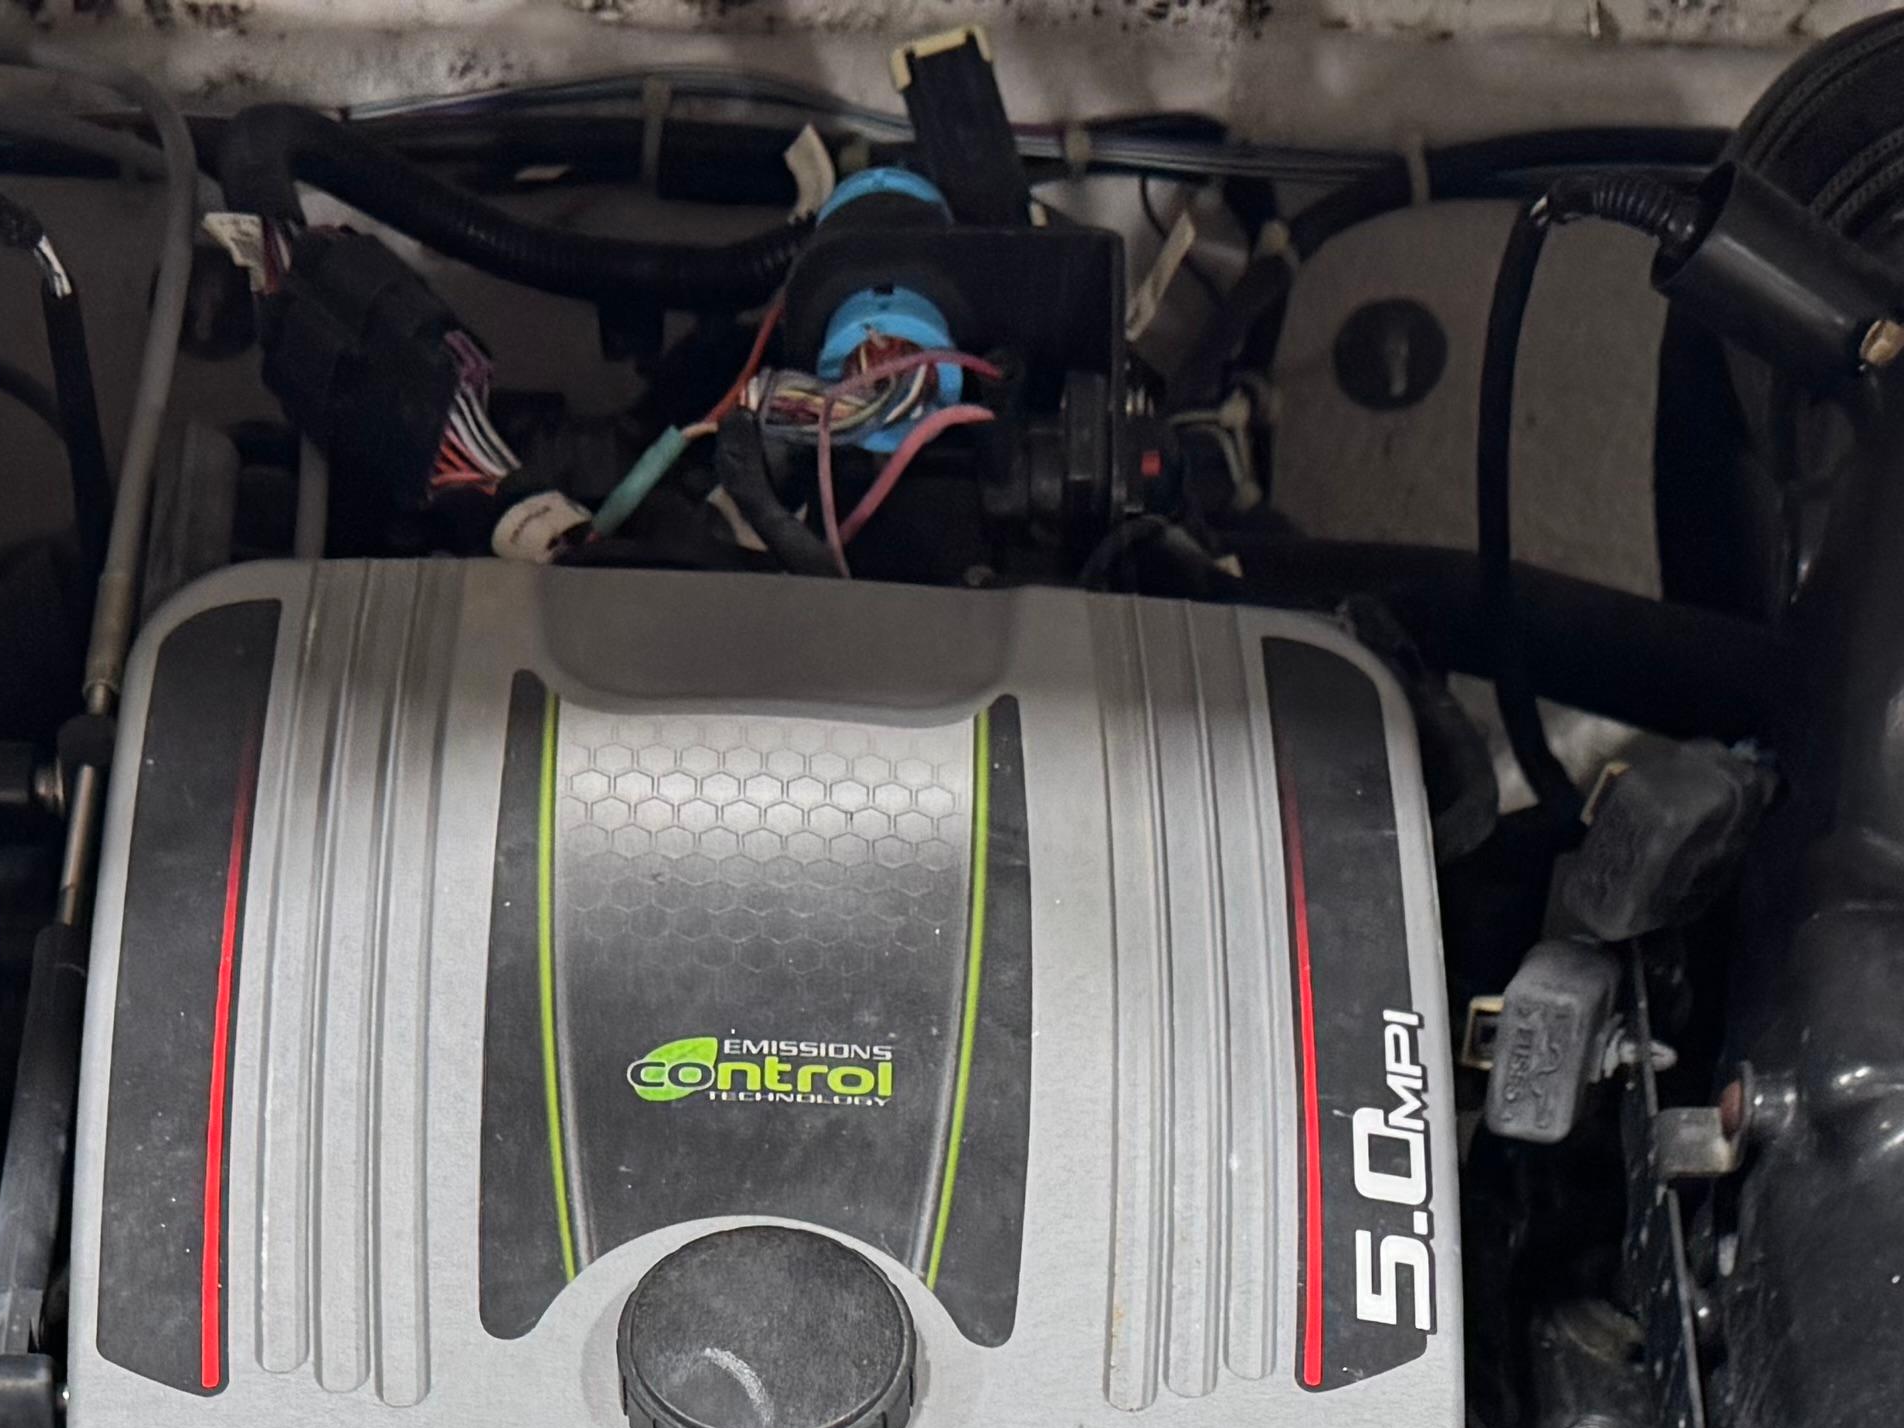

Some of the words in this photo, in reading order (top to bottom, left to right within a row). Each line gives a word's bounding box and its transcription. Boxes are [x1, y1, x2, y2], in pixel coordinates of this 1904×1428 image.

[724, 1038, 893, 1060] EMISSIONS
[626, 1055, 893, 1097] control
[708, 1090, 890, 1107] TECHNOLOGY
